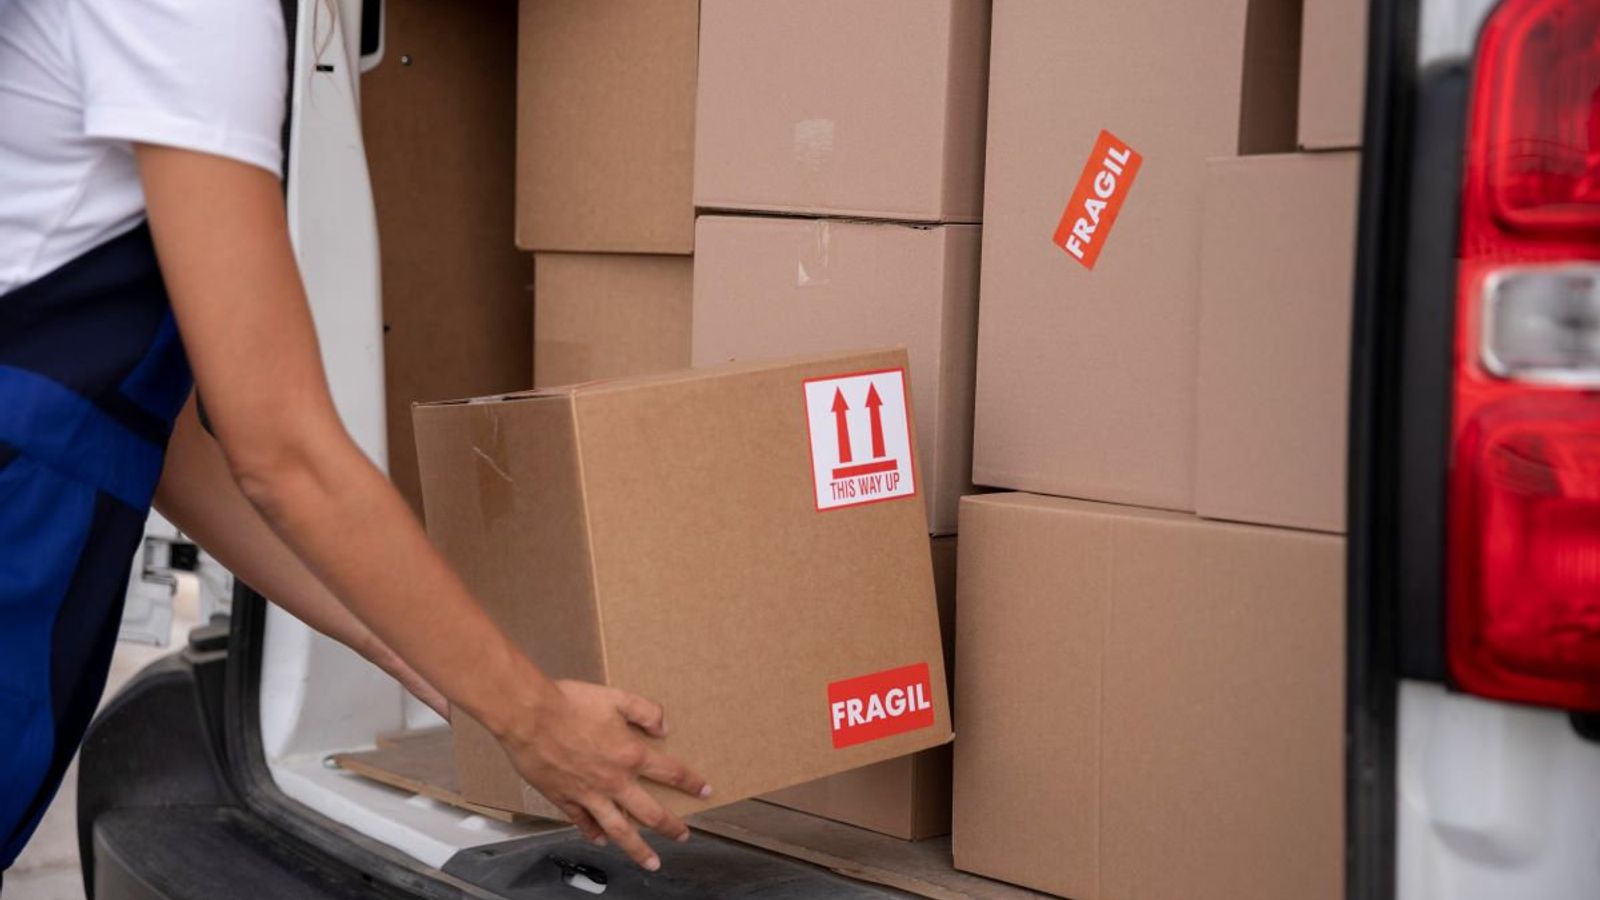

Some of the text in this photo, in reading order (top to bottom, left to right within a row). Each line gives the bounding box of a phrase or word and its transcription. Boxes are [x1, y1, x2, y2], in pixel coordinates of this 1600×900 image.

[1065, 146, 1131, 259] FRAGIL
[830, 472, 900, 500] THIS WAY UP
[832, 683, 931, 730] FRAGIL
